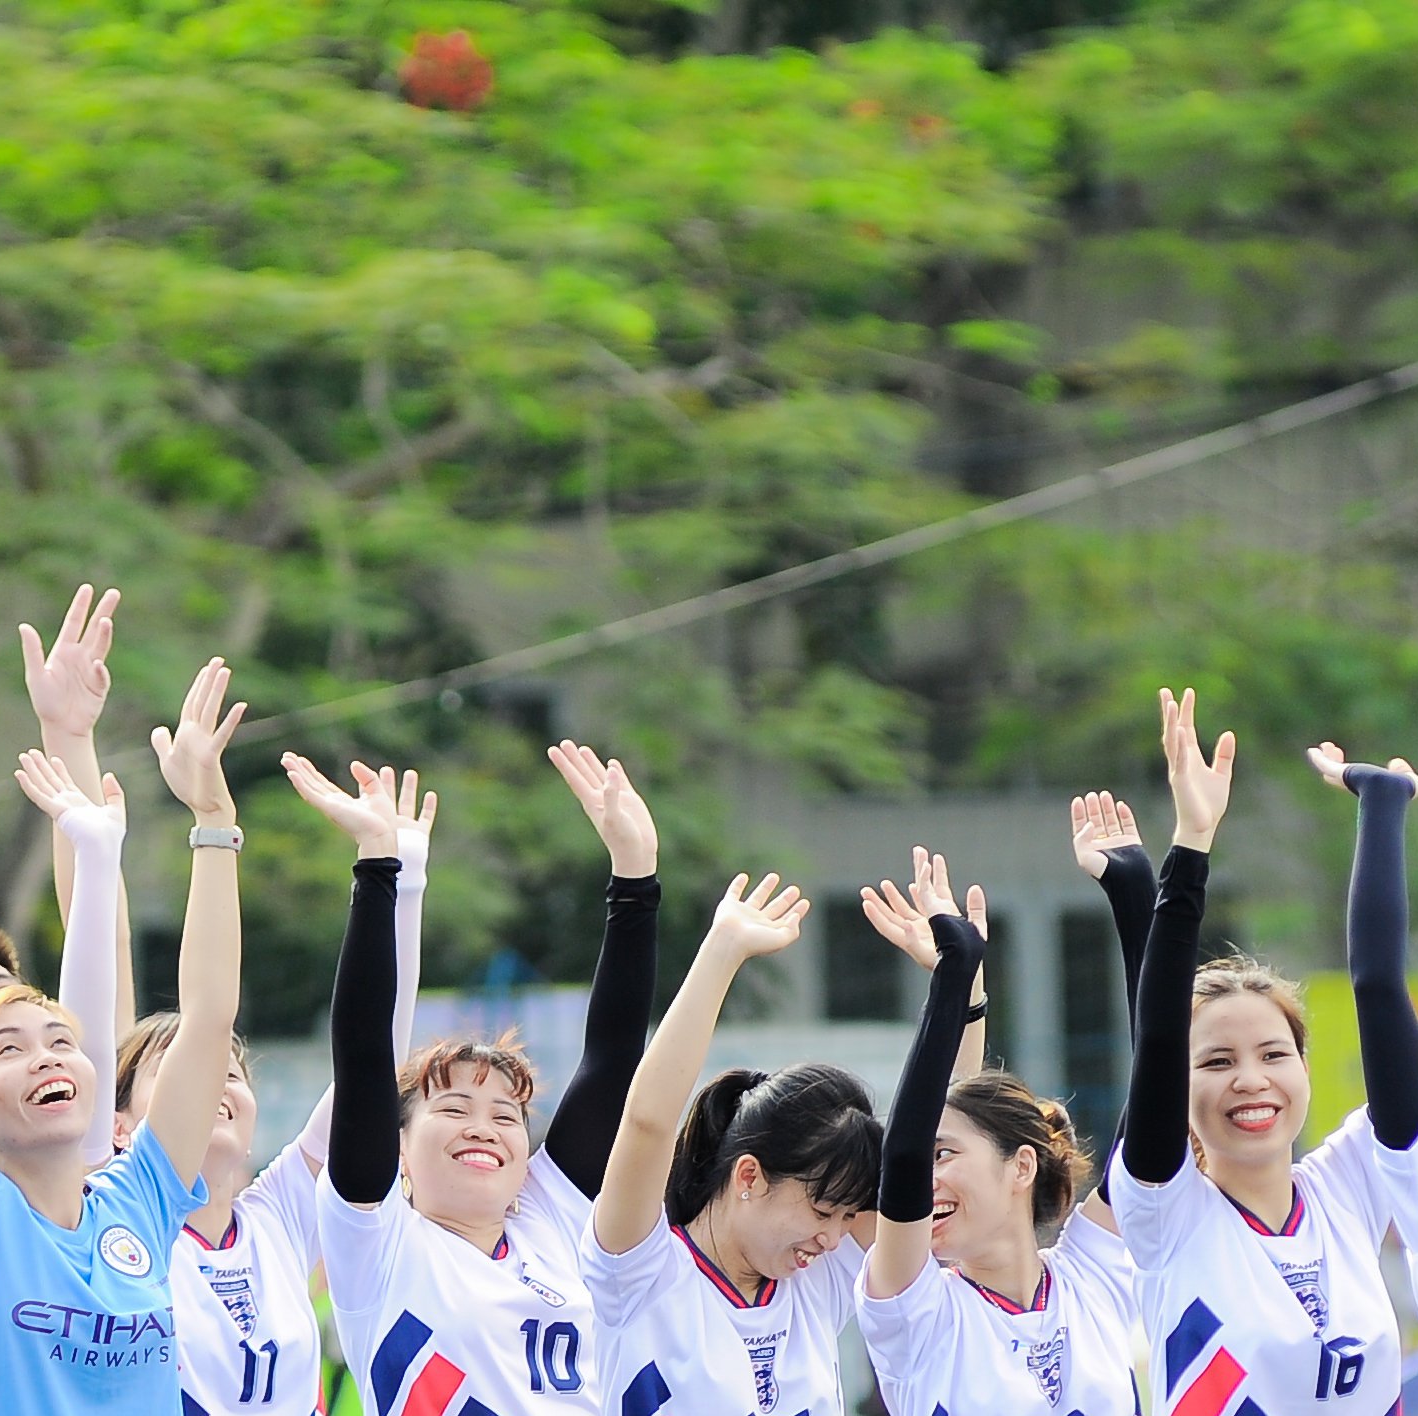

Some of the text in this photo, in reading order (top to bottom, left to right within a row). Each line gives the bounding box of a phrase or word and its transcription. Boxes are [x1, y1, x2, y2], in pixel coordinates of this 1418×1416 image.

[49, 1344, 169, 1367] AIRWAYS
[238, 1338, 280, 1405] 11
[520, 1318, 585, 1395] 10
[1293, 1331, 1367, 1401] 16
